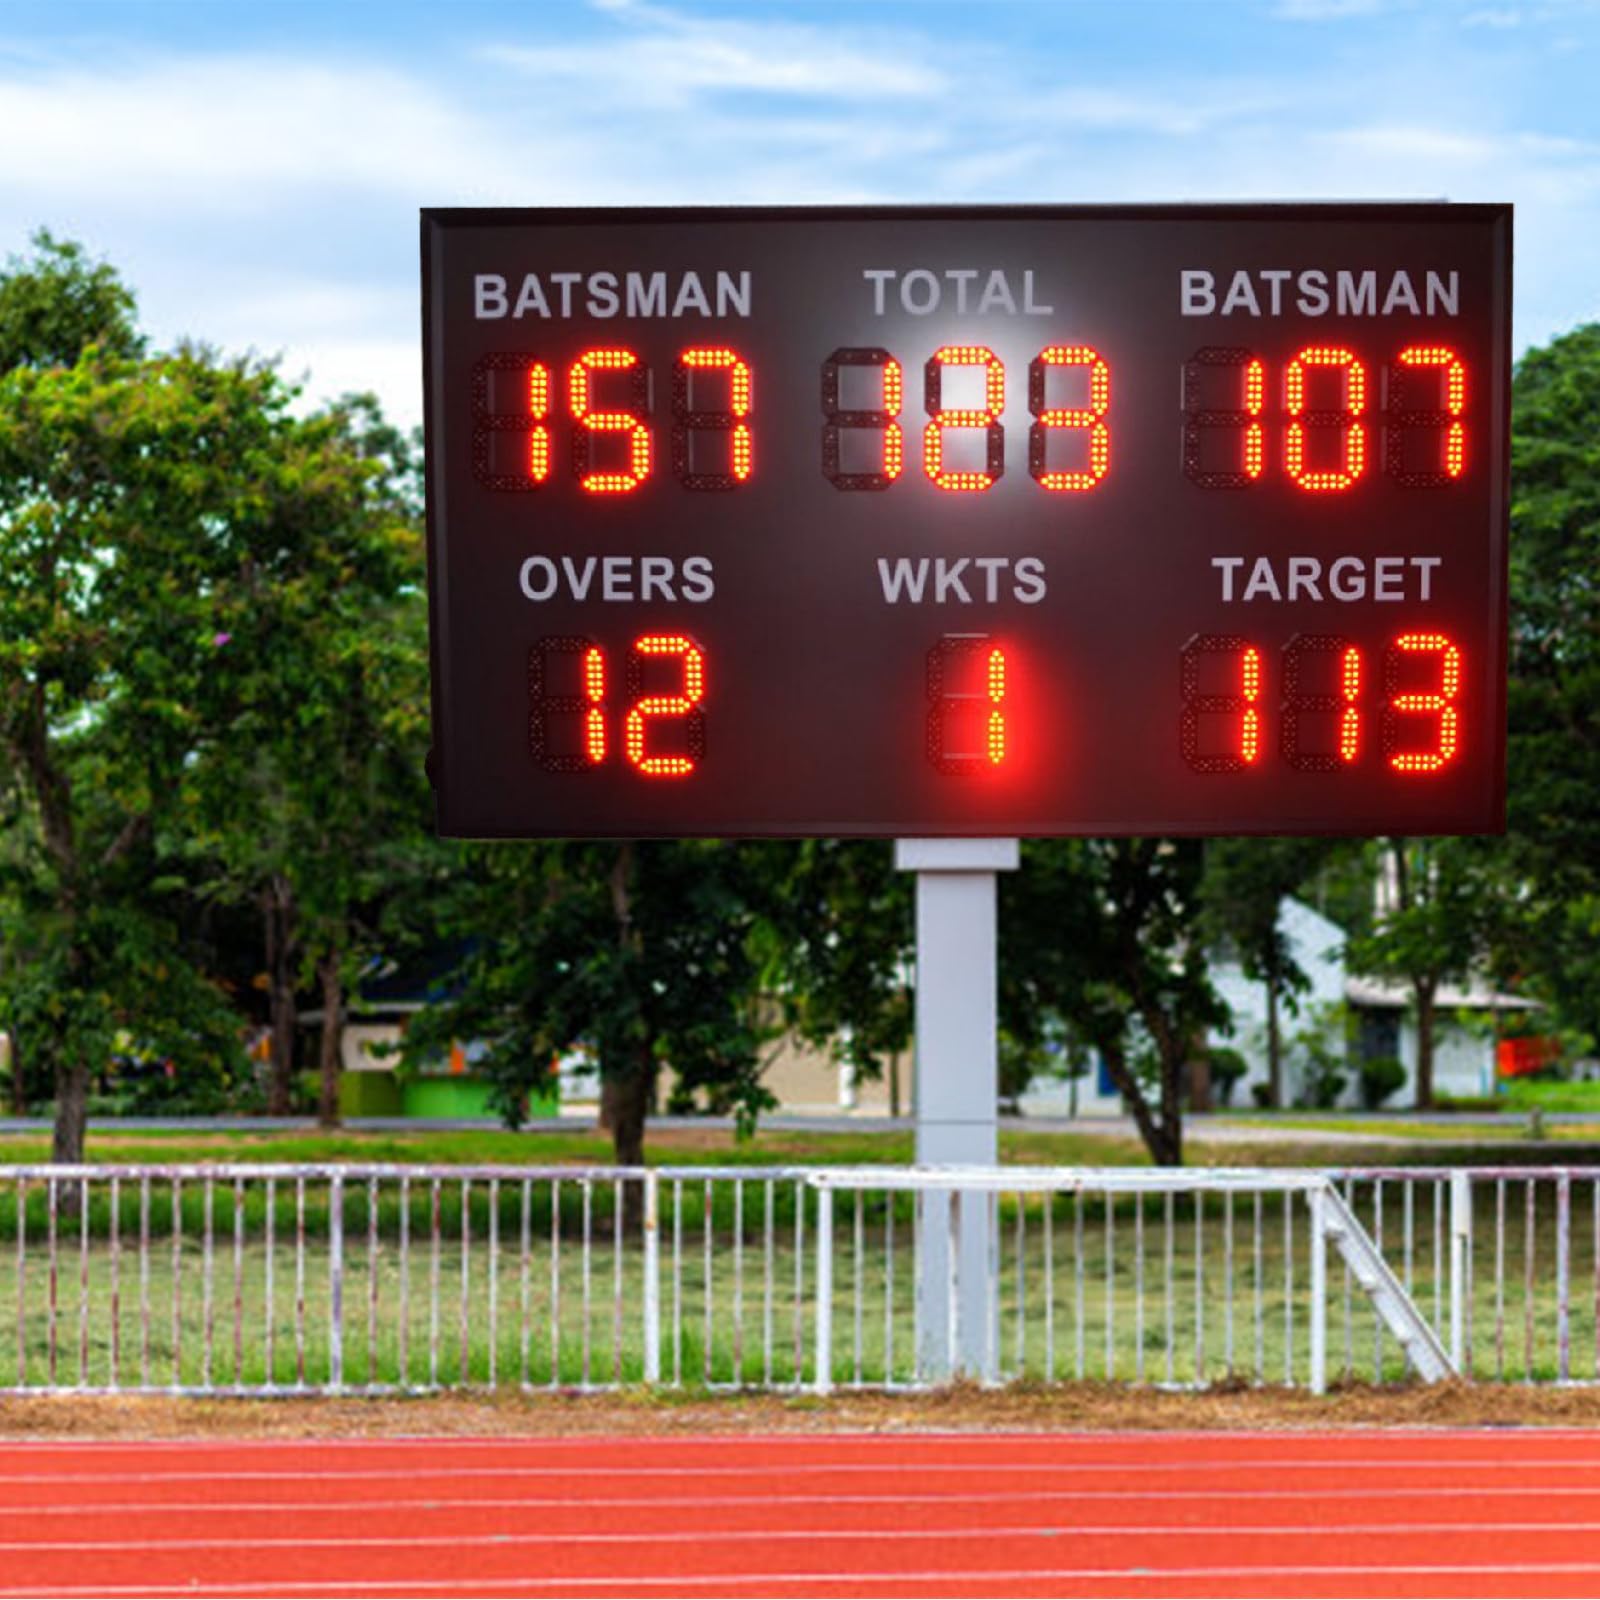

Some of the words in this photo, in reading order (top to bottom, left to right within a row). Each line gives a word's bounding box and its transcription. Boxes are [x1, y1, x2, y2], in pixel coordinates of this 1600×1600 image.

[474, 271, 752, 319] BATSMAN
[863, 269, 1054, 315] TOTAL
[1180, 270, 1460, 316] BATSMAN
[529, 347, 755, 493] 157
[882, 346, 1110, 491] 123
[1244, 347, 1466, 491] 107
[519, 556, 715, 602] OVERS
[877, 557, 1048, 604] WKTS
[1212, 556, 1442, 602] TARGET
[585, 633, 704, 777] 12
[986, 648, 1006, 765] 1
[1241, 633, 1460, 772] 113
